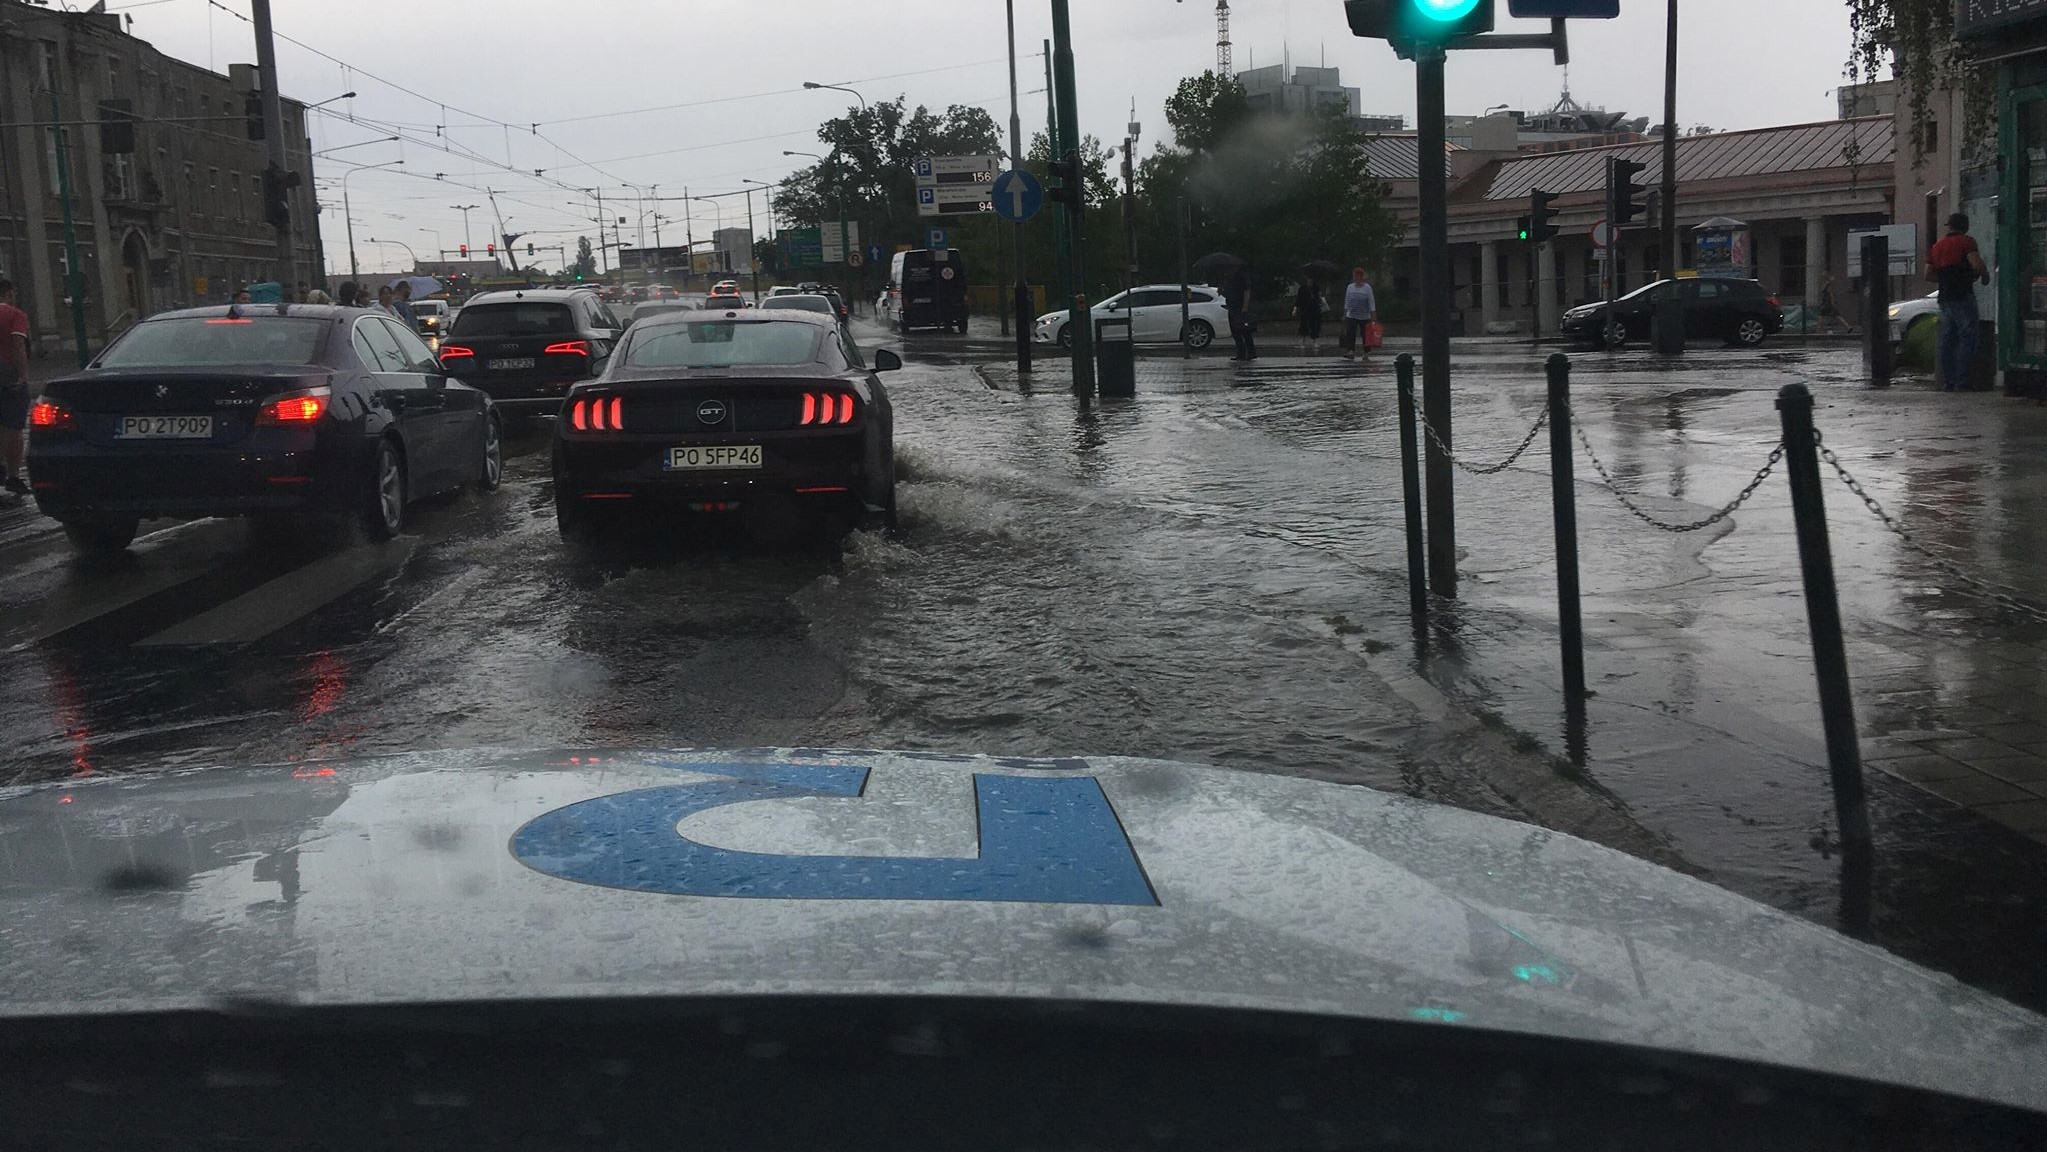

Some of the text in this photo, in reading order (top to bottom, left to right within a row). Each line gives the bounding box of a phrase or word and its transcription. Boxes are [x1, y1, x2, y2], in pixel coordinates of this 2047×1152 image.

[920, 162, 929, 174] P
[972, 171, 992, 182] 156
[922, 190, 931, 202] P
[979, 202, 993, 212] 94
[931, 231, 943, 247] P
[125, 417, 209, 434] PO 2T909
[674, 449, 699, 465] PO
[706, 447, 759, 465] 5FP46
